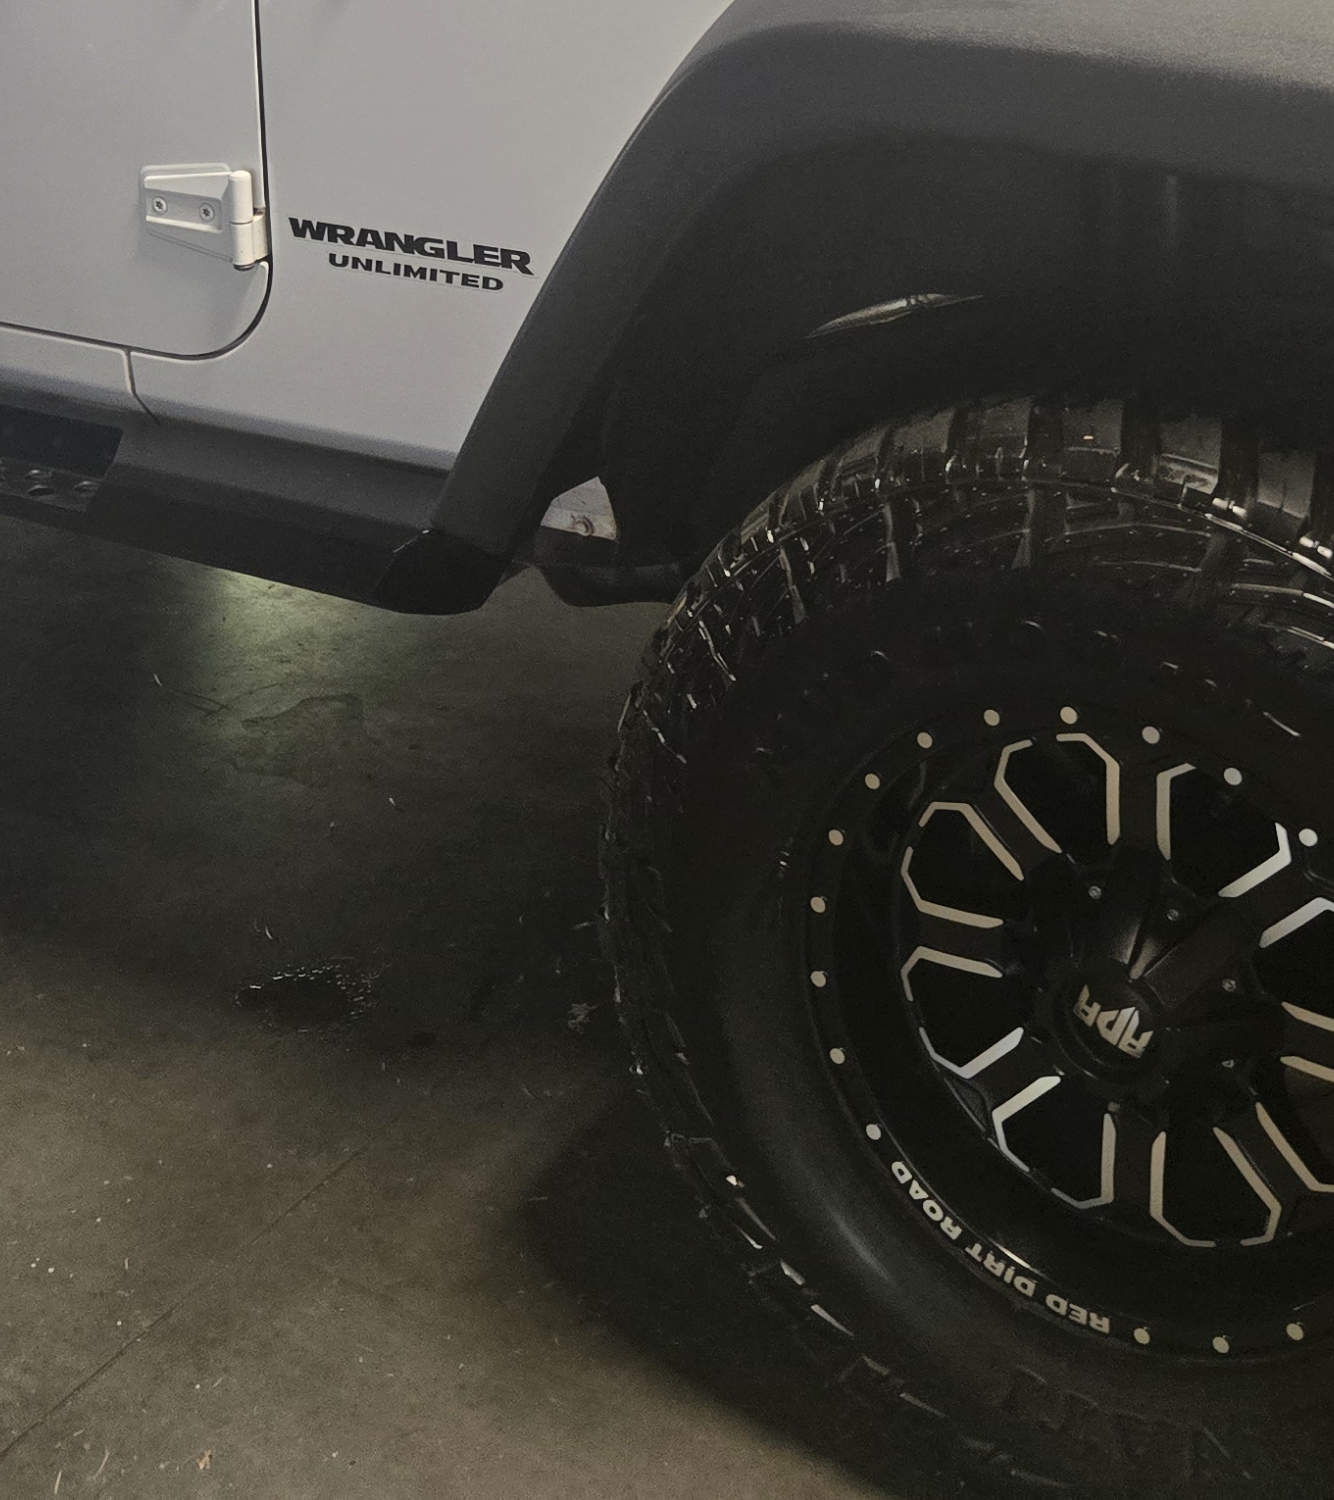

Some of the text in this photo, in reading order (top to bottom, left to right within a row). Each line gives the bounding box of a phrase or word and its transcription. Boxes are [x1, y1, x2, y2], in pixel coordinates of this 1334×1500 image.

[288, 217, 535, 277] WRANGLER
[328, 252, 504, 291] UNLIMITED
[890, 1160, 1111, 1335] RED DIRT ROAD
